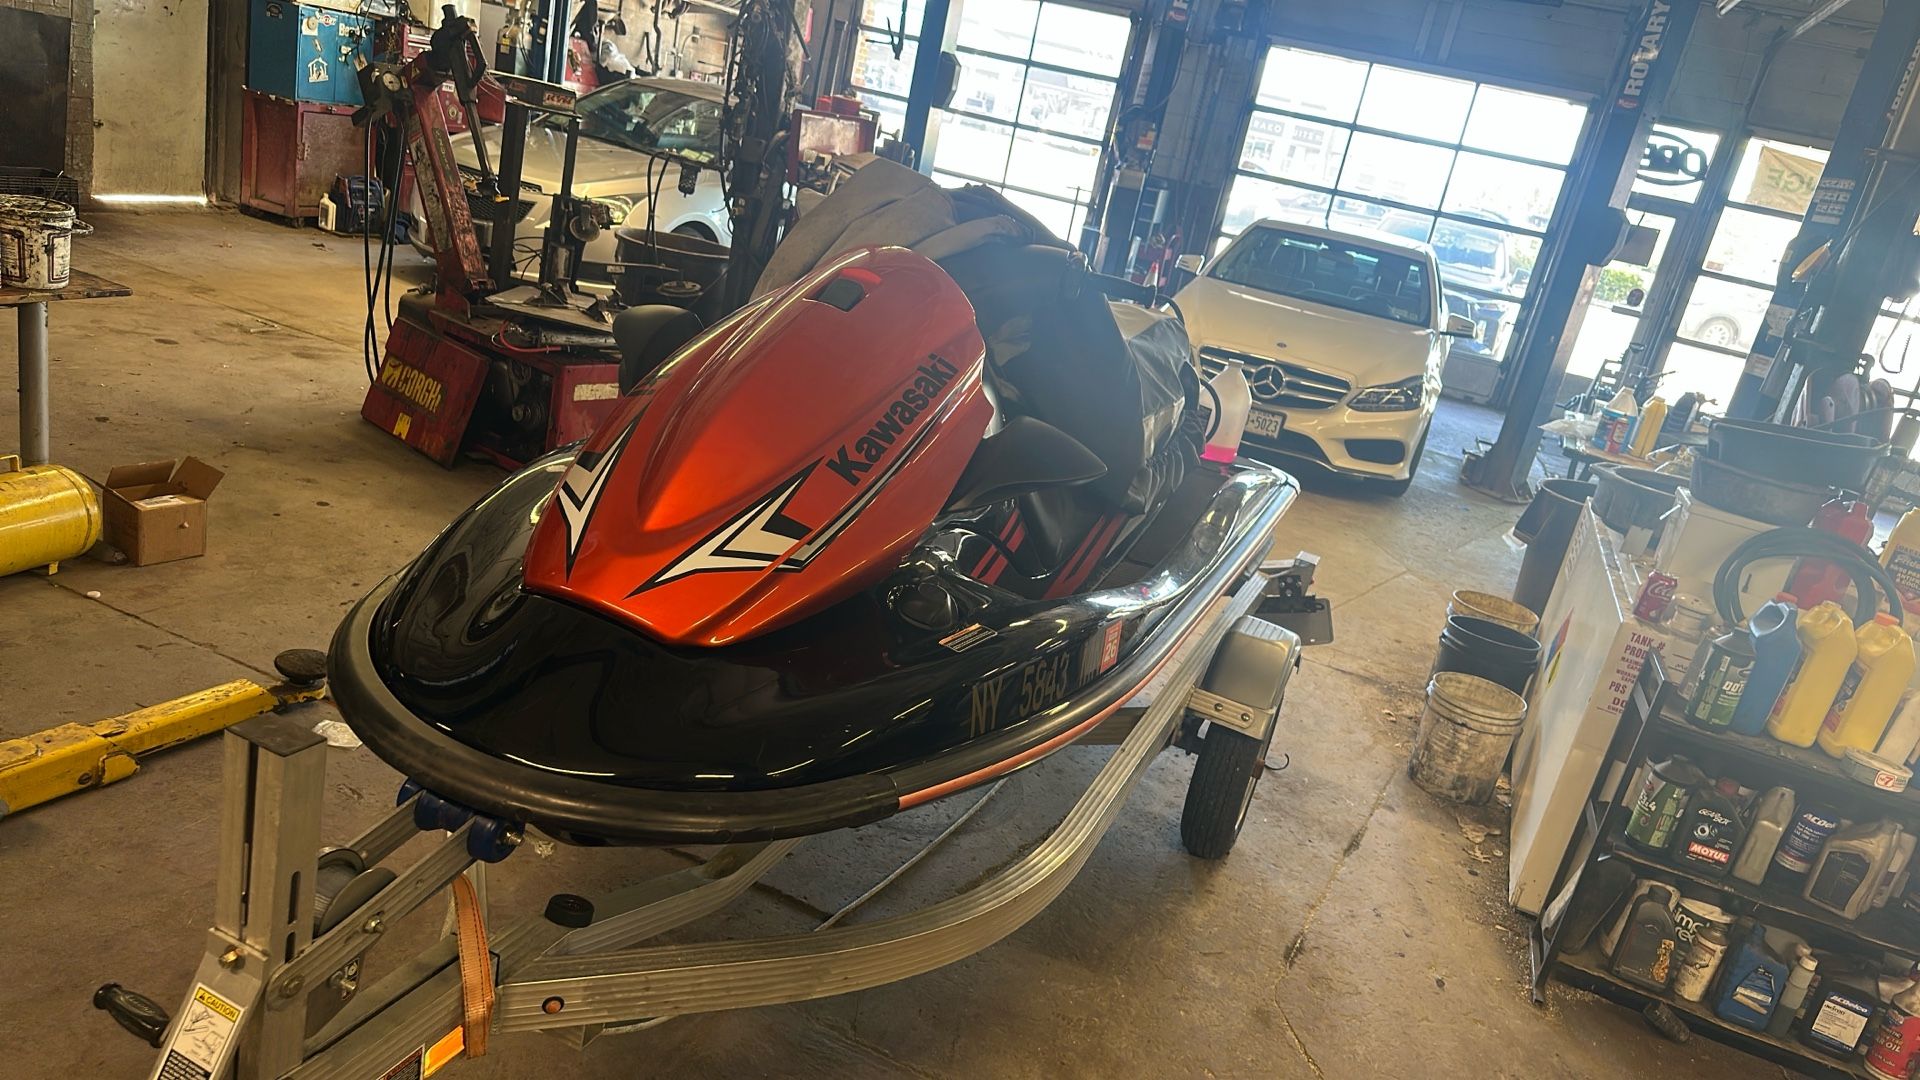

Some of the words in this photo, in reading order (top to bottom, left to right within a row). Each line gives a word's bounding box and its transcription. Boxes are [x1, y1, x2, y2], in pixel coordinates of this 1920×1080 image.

[1624, 0, 1670, 96] ROTARY
[825, 353, 960, 487] Kawasaki
[1104, 639, 1118, 662] 26
[1630, 632, 1655, 648] TANK
[970, 673, 1008, 739] NY
[1019, 652, 1070, 717] 5843
[1690, 843, 1728, 862] MOTUL
[205, 994, 237, 1019] CAUTION
